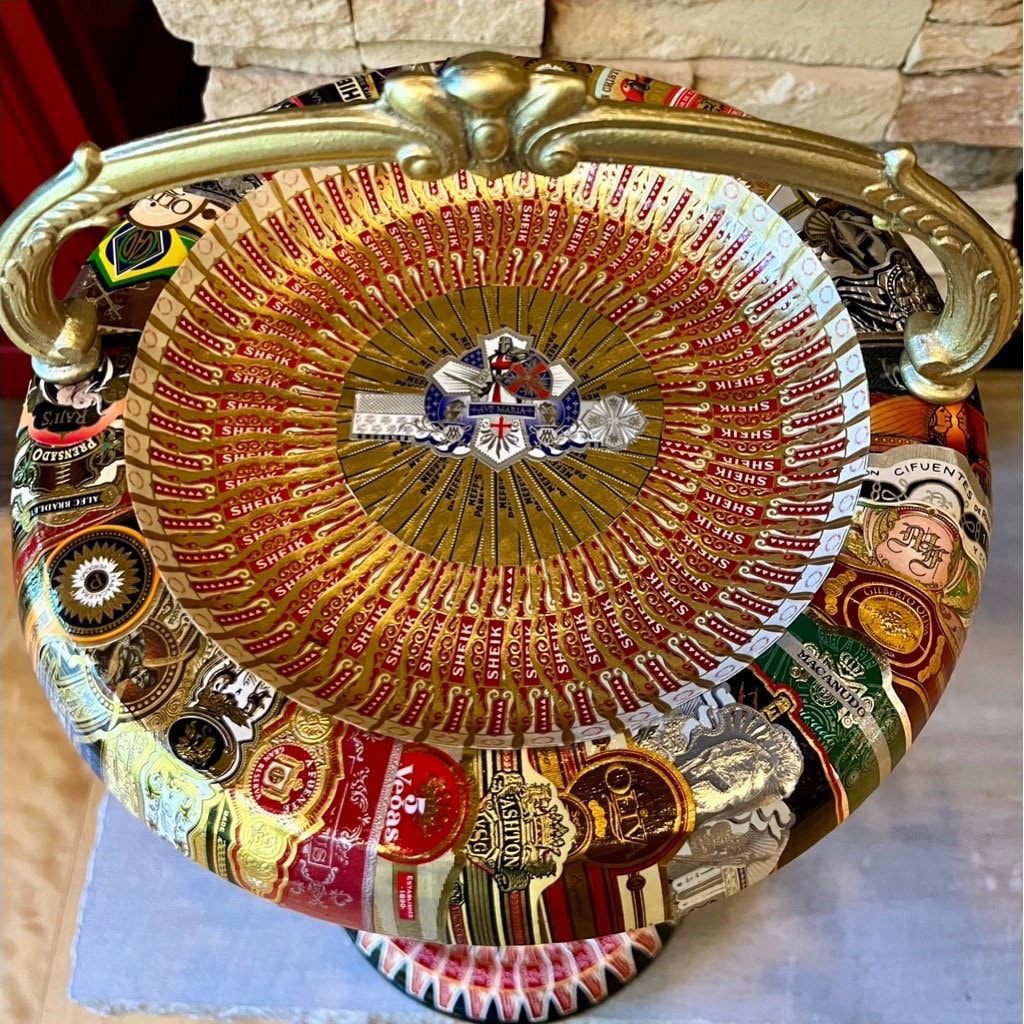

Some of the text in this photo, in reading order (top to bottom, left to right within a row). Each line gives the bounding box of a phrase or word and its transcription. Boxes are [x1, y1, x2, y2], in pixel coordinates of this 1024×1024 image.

[415, 217, 436, 254] SHEIK
[442, 210, 460, 247] SHEIK
[470, 205, 484, 242] SHEIK
[517, 205, 533, 243] SHEIK
[567, 216, 589, 252] SHEIK
[590, 223, 616, 258] SHEIK
[337, 248, 369, 282] SHEIK
[362, 235, 391, 270] SHEIK
[609, 236, 639, 270] SHEIK
[652, 265, 688, 296] SHEIK
[697, 325, 742, 348] SHEIK
[243, 346, 291, 366] SHEIK
[716, 374, 765, 390] SHEIK
[32, 440, 98, 462] PRENSADO
[721, 428, 773, 439] SHEIK
[716, 466, 767, 486] SHEIK
[894, 462, 974, 500] CIFUENTES
[230, 492, 283, 516] SHEIK
[704, 491, 755, 516] SHEIK
[695, 515, 745, 544] SHEIK
[256, 537, 306, 570] SHEIK
[647, 572, 689, 615] SHEIK
[864, 586, 916, 607] GILBERTO
[351, 605, 387, 653] SHEIK
[574, 612, 601, 664] SHEIK
[452, 622, 473, 676] SHEIK
[487, 626, 502, 679] SHEIK
[797, 650, 867, 718] MACANUDO
[385, 764, 426, 843] 5 Vegas
[501, 795, 520, 868] ASHTON
